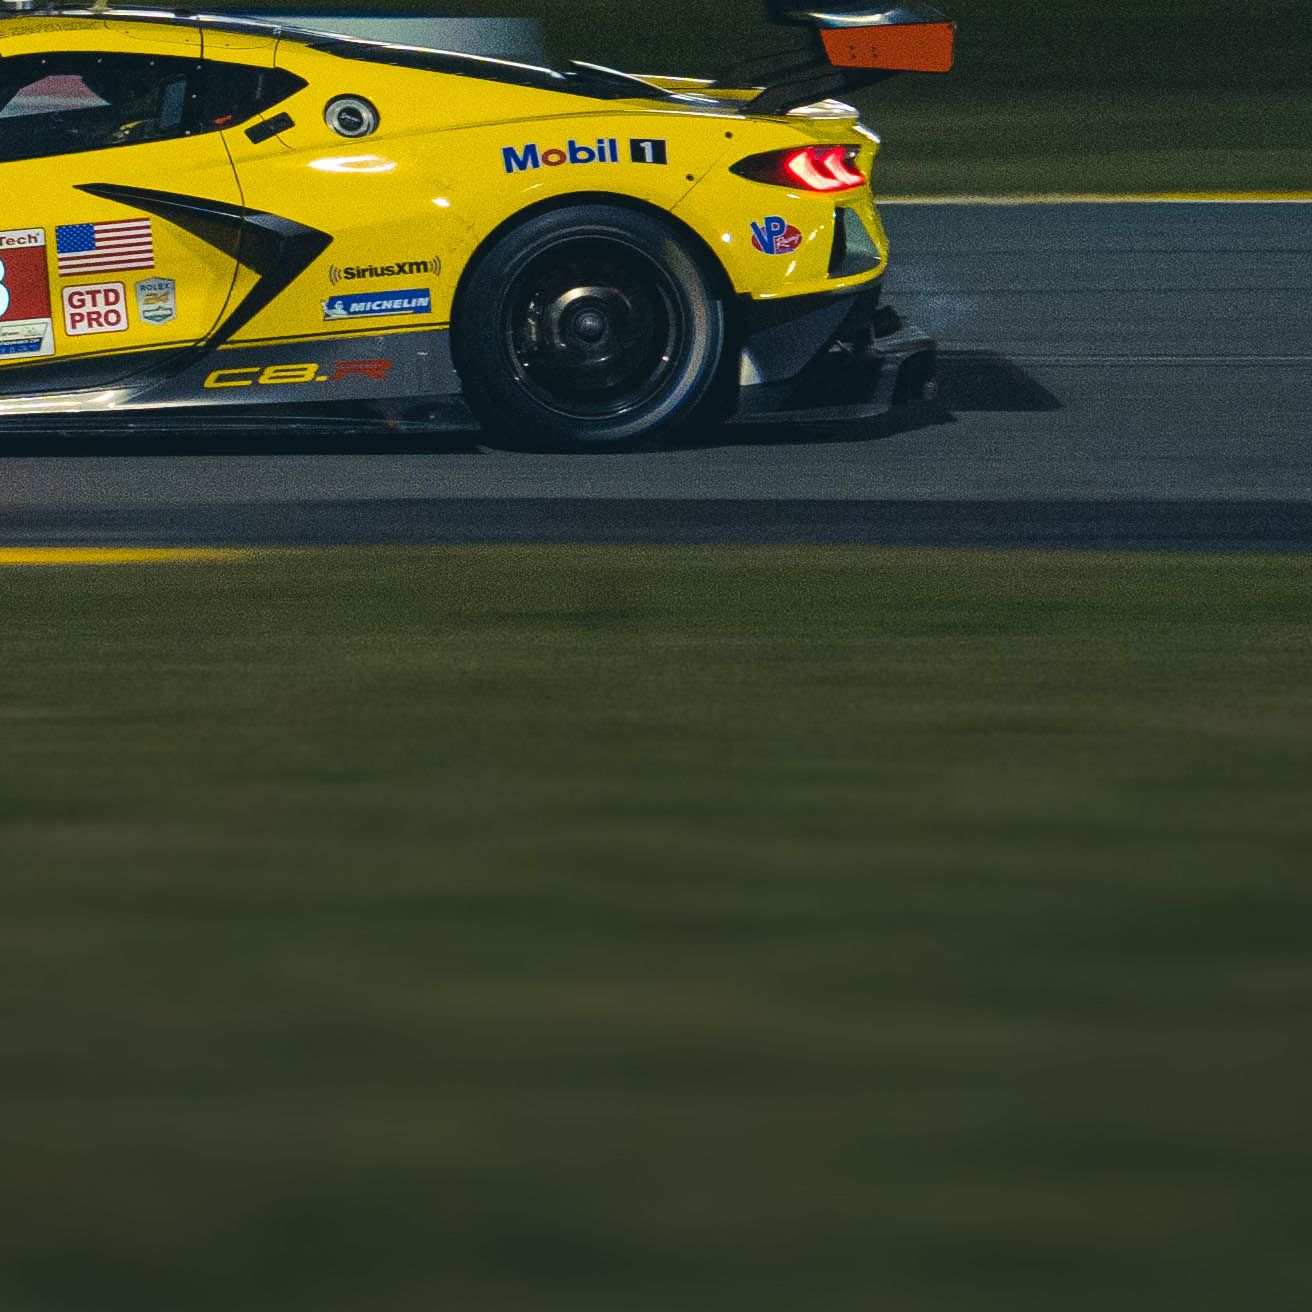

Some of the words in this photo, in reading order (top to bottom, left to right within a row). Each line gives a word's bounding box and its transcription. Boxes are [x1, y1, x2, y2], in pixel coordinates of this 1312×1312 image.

[502, 138, 619, 174] Mobil
[750, 215, 786, 255] VP
[68, 288, 121, 309] GTD
[350, 297, 430, 313] MICHELIN
[70, 309, 122, 330] PRO
